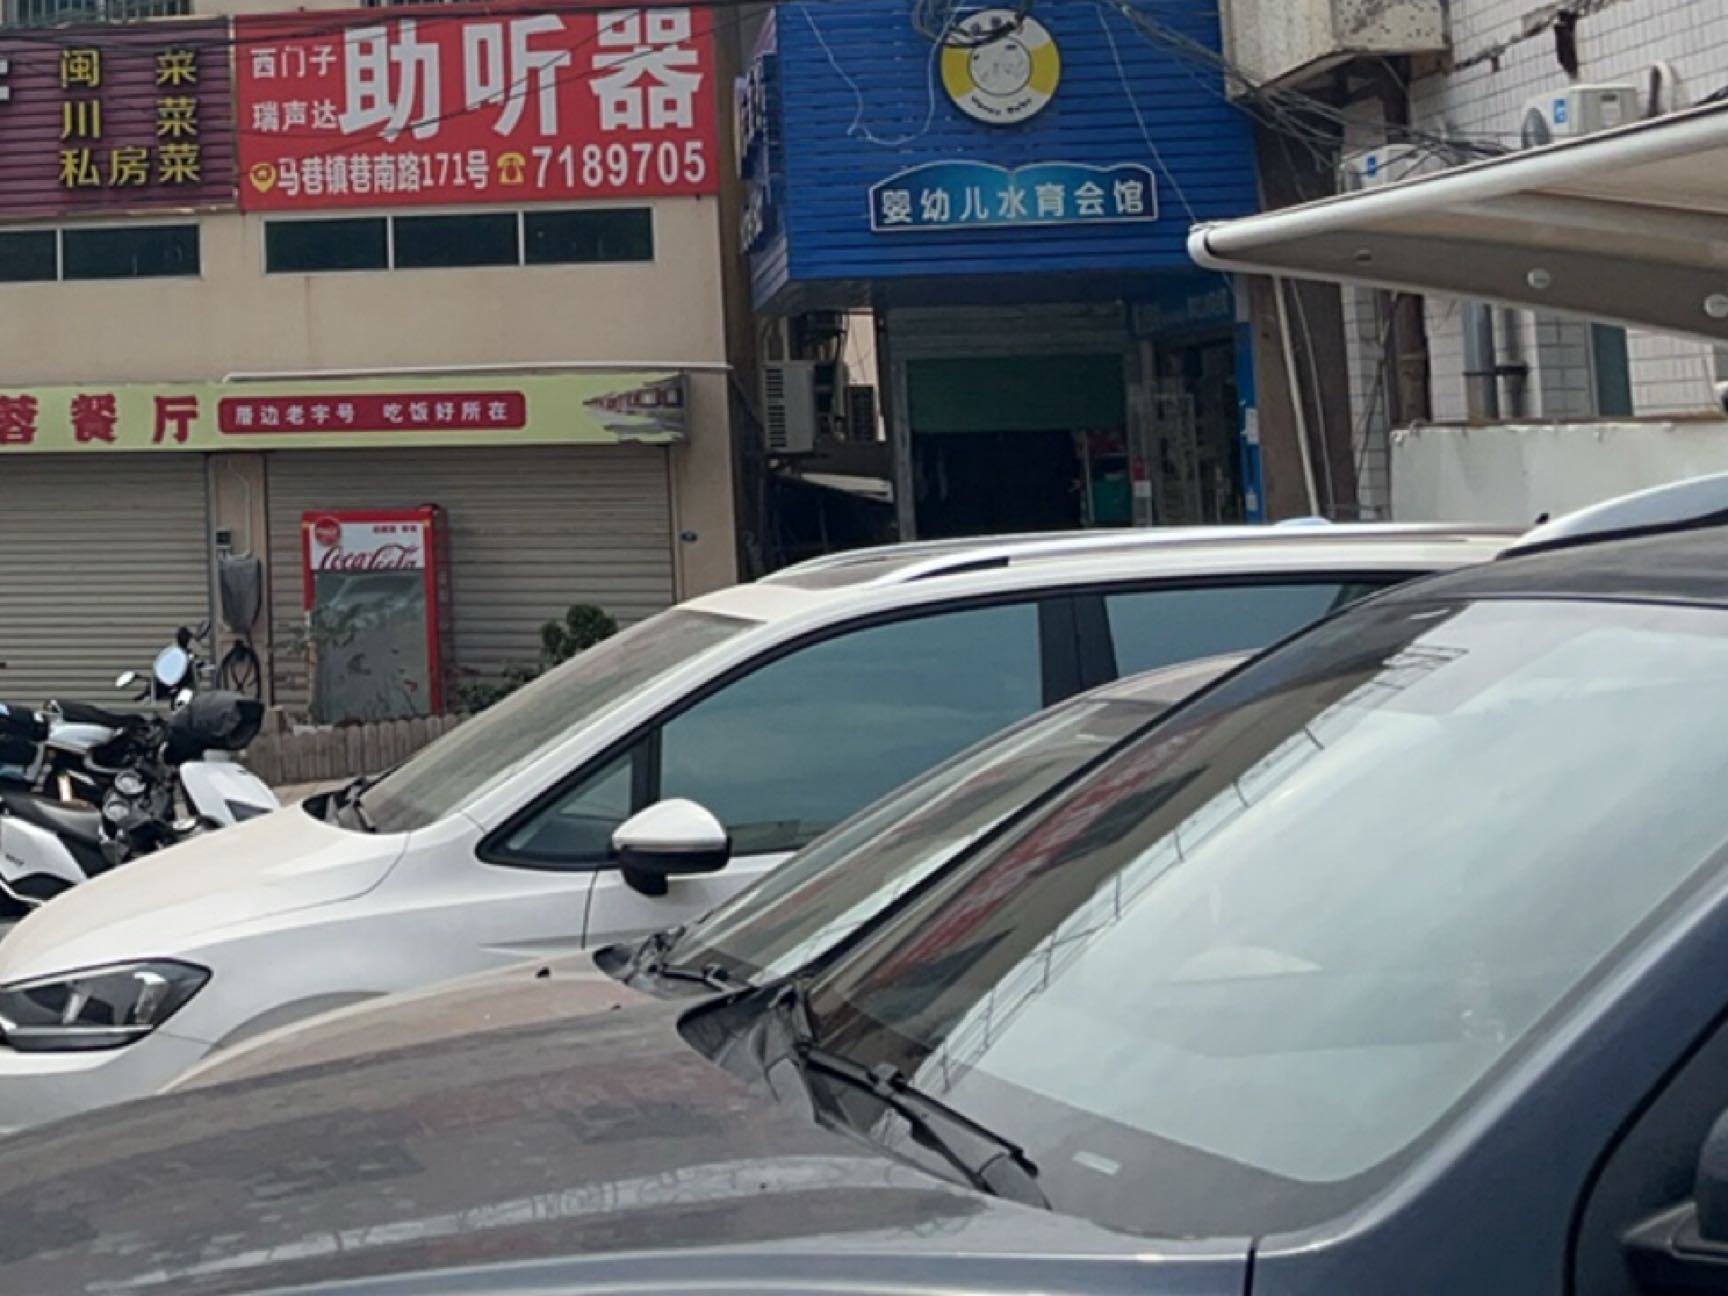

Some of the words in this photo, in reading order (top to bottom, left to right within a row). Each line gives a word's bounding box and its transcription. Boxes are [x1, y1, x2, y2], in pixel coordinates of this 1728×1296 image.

[250, 44, 338, 79] 西门子
[338, 7, 705, 143] 助听器
[250, 98, 339, 133] 瑞声达
[59, 142, 202, 188] 私房菜
[276, 148, 491, 197] 马巷镇巷南路171号
[532, 141, 707, 189] 7189705
[881, 179, 1145, 225] 婴幼儿水育会馆
[382, 399, 508, 424] 吃饭好所在
